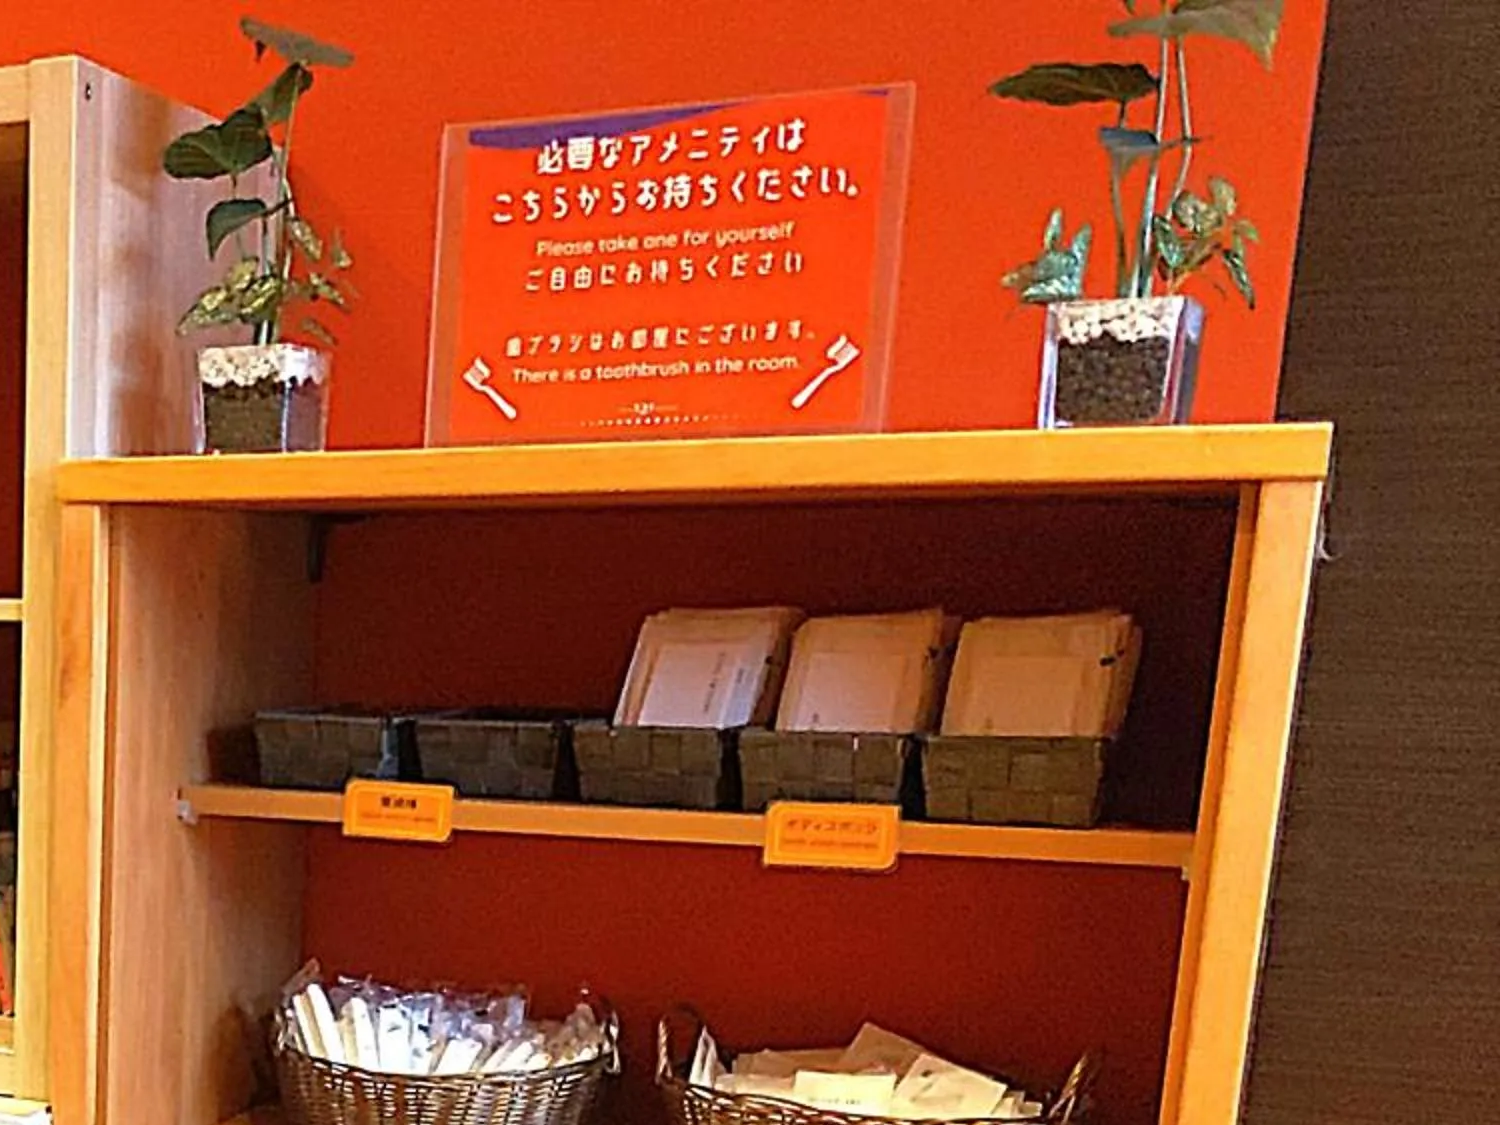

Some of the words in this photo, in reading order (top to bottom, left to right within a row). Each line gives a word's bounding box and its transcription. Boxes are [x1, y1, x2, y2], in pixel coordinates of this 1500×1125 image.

[536, 117, 806, 175] 必要なアメニティは
[492, 163, 859, 223] こちらからお持ちください。
[536, 240, 595, 256] Please
[598, 234, 639, 253] take
[643, 234, 678, 250] one
[683, 228, 710, 247] for
[714, 220, 795, 249] yourself
[525, 250, 803, 292] ご自由にお持ちください
[513, 367, 560, 384] There
[563, 367, 577, 382] is
[579, 367, 593, 381] a
[595, 360, 690, 383] toothbrush
[694, 360, 711, 374] in
[715, 356, 744, 375] the
